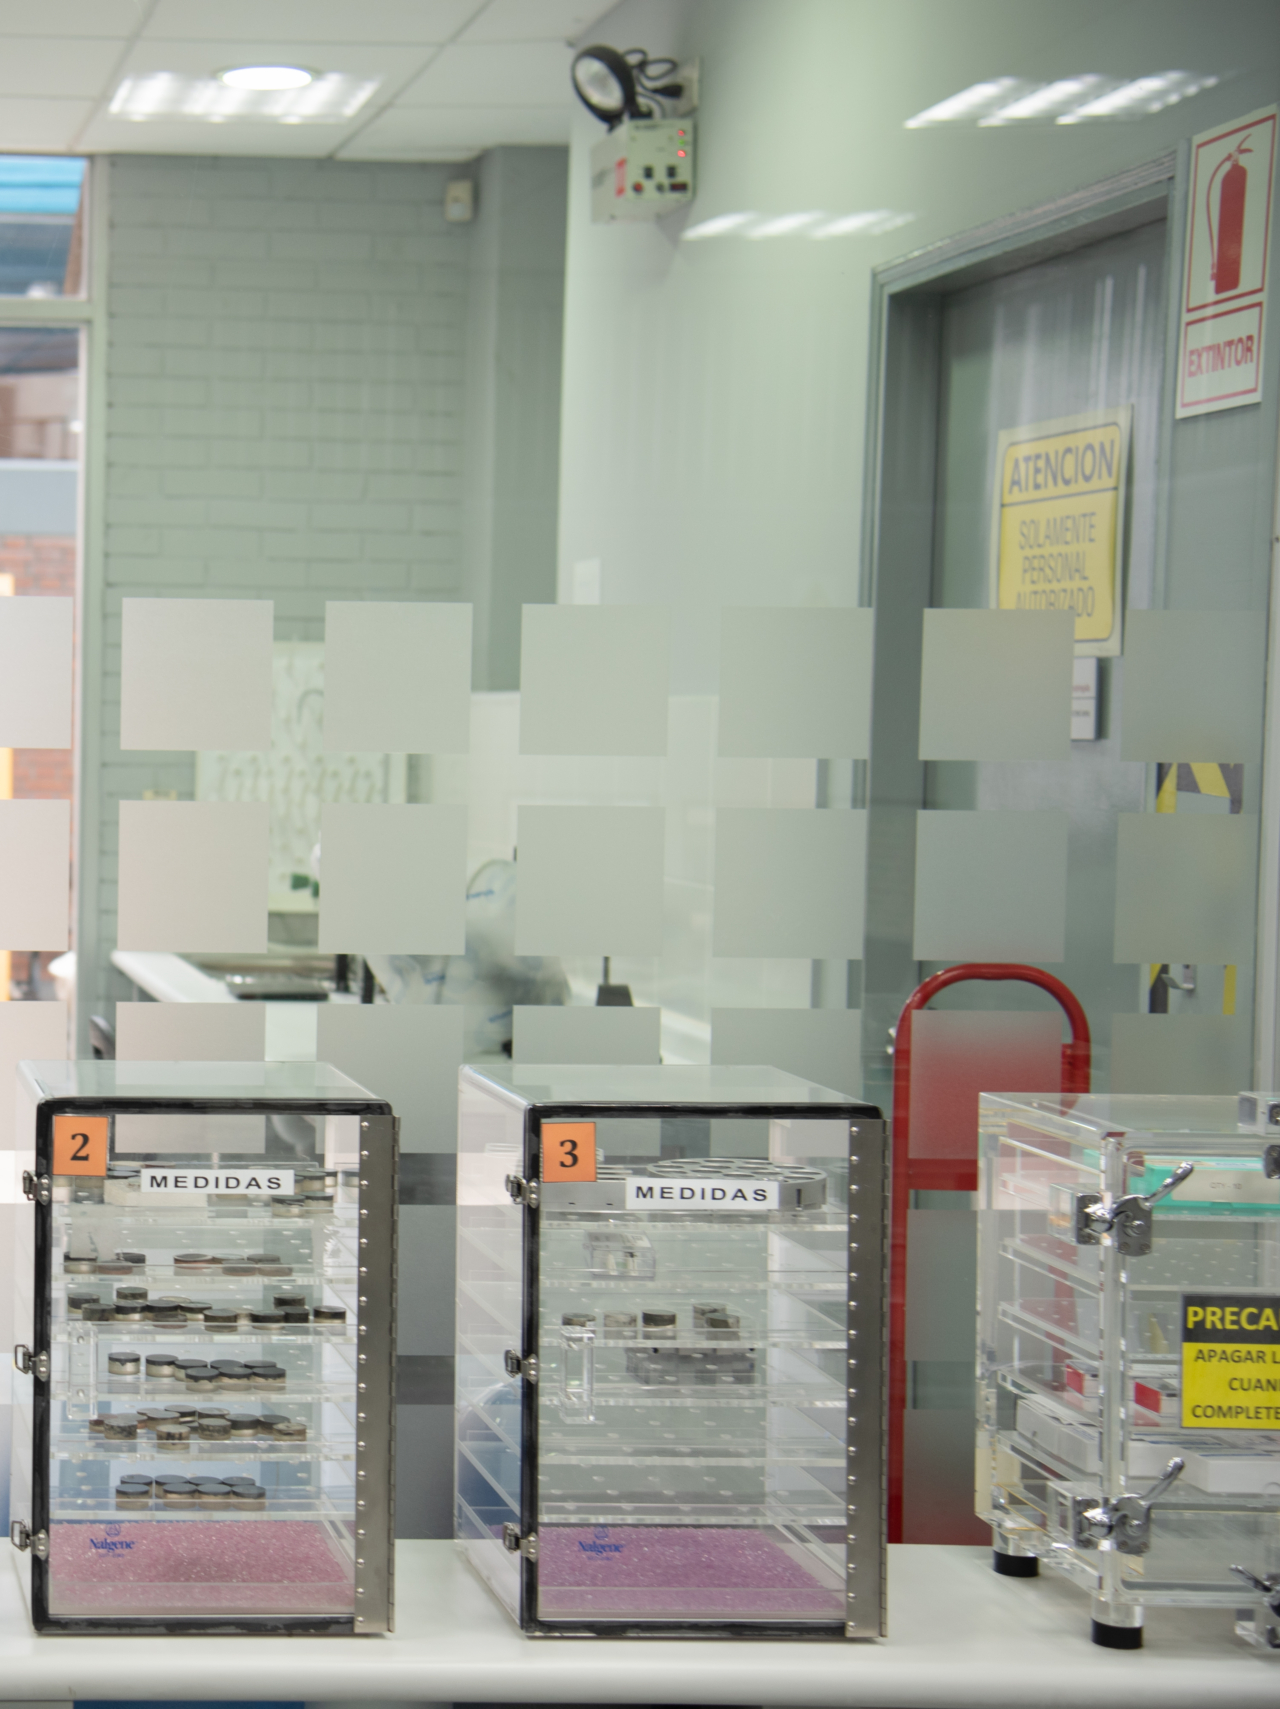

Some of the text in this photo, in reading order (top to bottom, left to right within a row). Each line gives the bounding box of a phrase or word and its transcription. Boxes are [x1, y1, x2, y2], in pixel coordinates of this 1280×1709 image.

[1187, 333, 1255, 378] EXTINTOR
[1007, 438, 1116, 495] ATENCION
[1019, 511, 1097, 550] SOLAMENTE
[1021, 550, 1090, 585] PERSONAL
[69, 1132, 90, 1162] 2
[558, 1139, 579, 1168] 3
[149, 1175, 282, 1190] MEDIDAS
[635, 1185, 768, 1202] MEDIDAS
[1186, 1306, 1280, 1331] PRECA
[1193, 1348, 1267, 1364] APAGAR
[1228, 1377, 1280, 1392] CUAN
[89, 1538, 135, 1553] Nalgene
[578, 1541, 624, 1556] Nalgene
